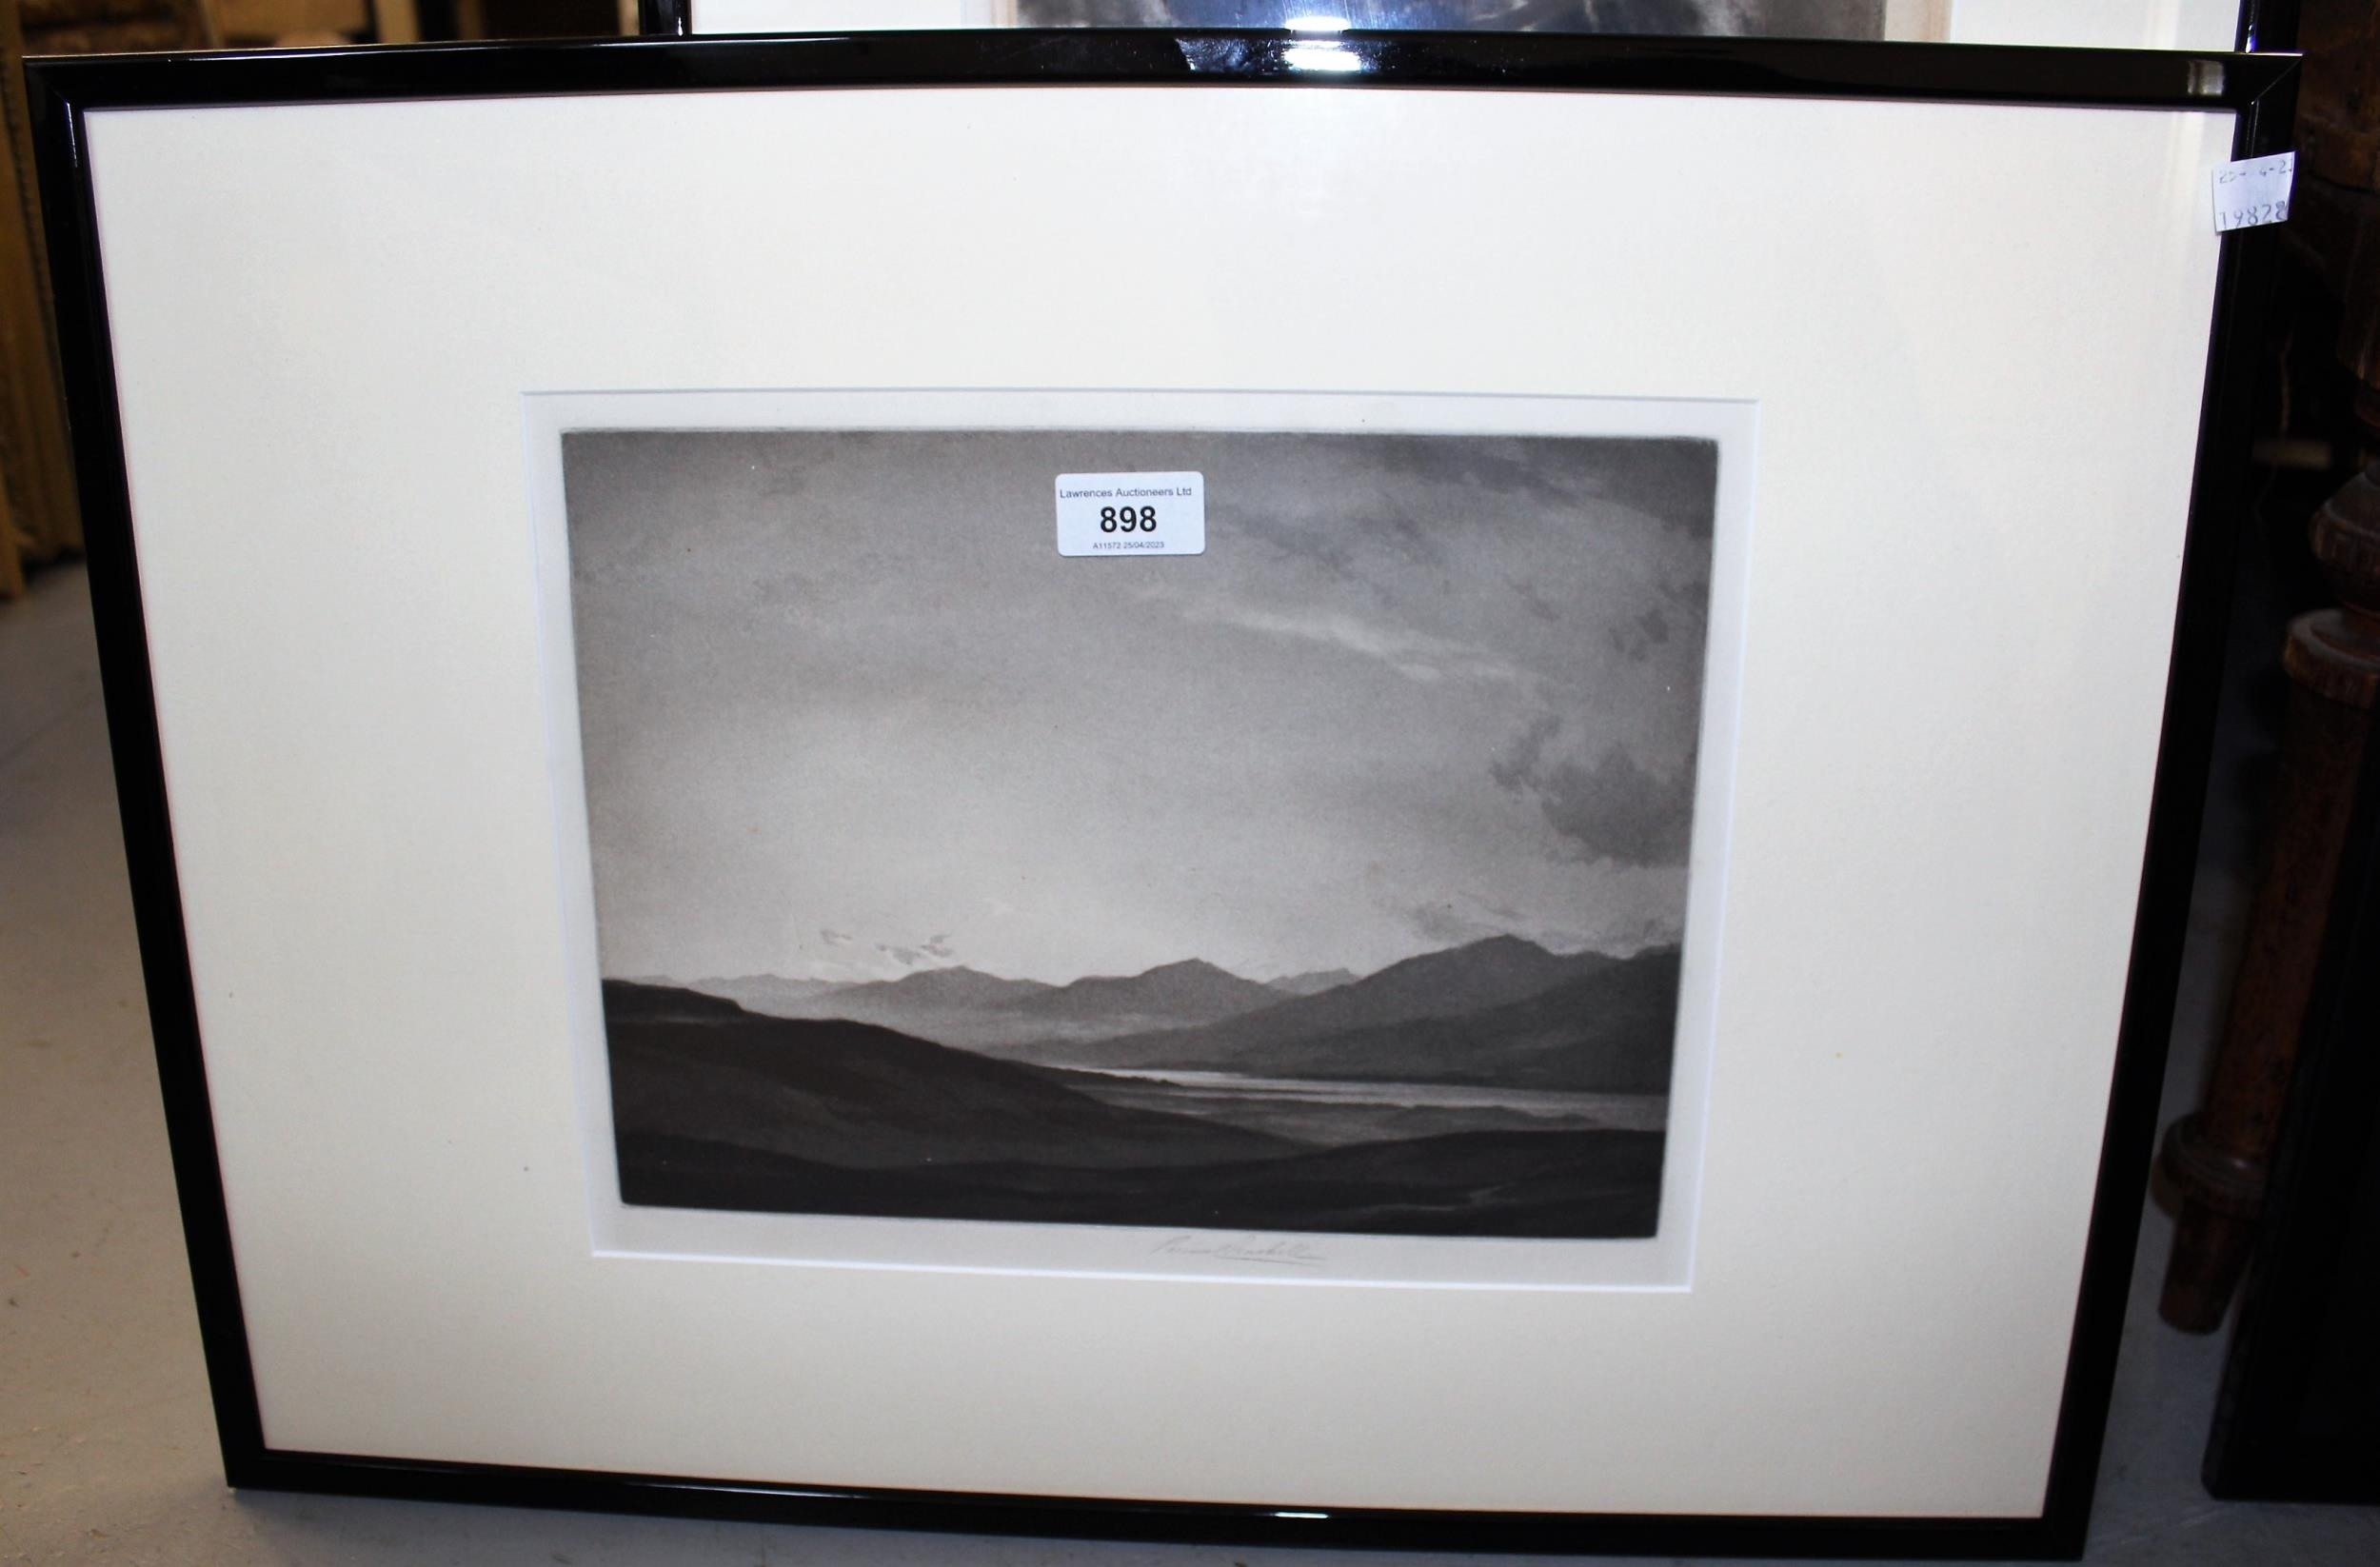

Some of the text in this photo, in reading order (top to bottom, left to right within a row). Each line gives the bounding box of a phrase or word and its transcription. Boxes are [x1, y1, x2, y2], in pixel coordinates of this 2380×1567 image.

[1060, 487, 1192, 499] Lawrences Auctioneers Ltd
[1100, 506, 1158, 533] 898
[1123, 541, 1164, 549] 25/04/2023
